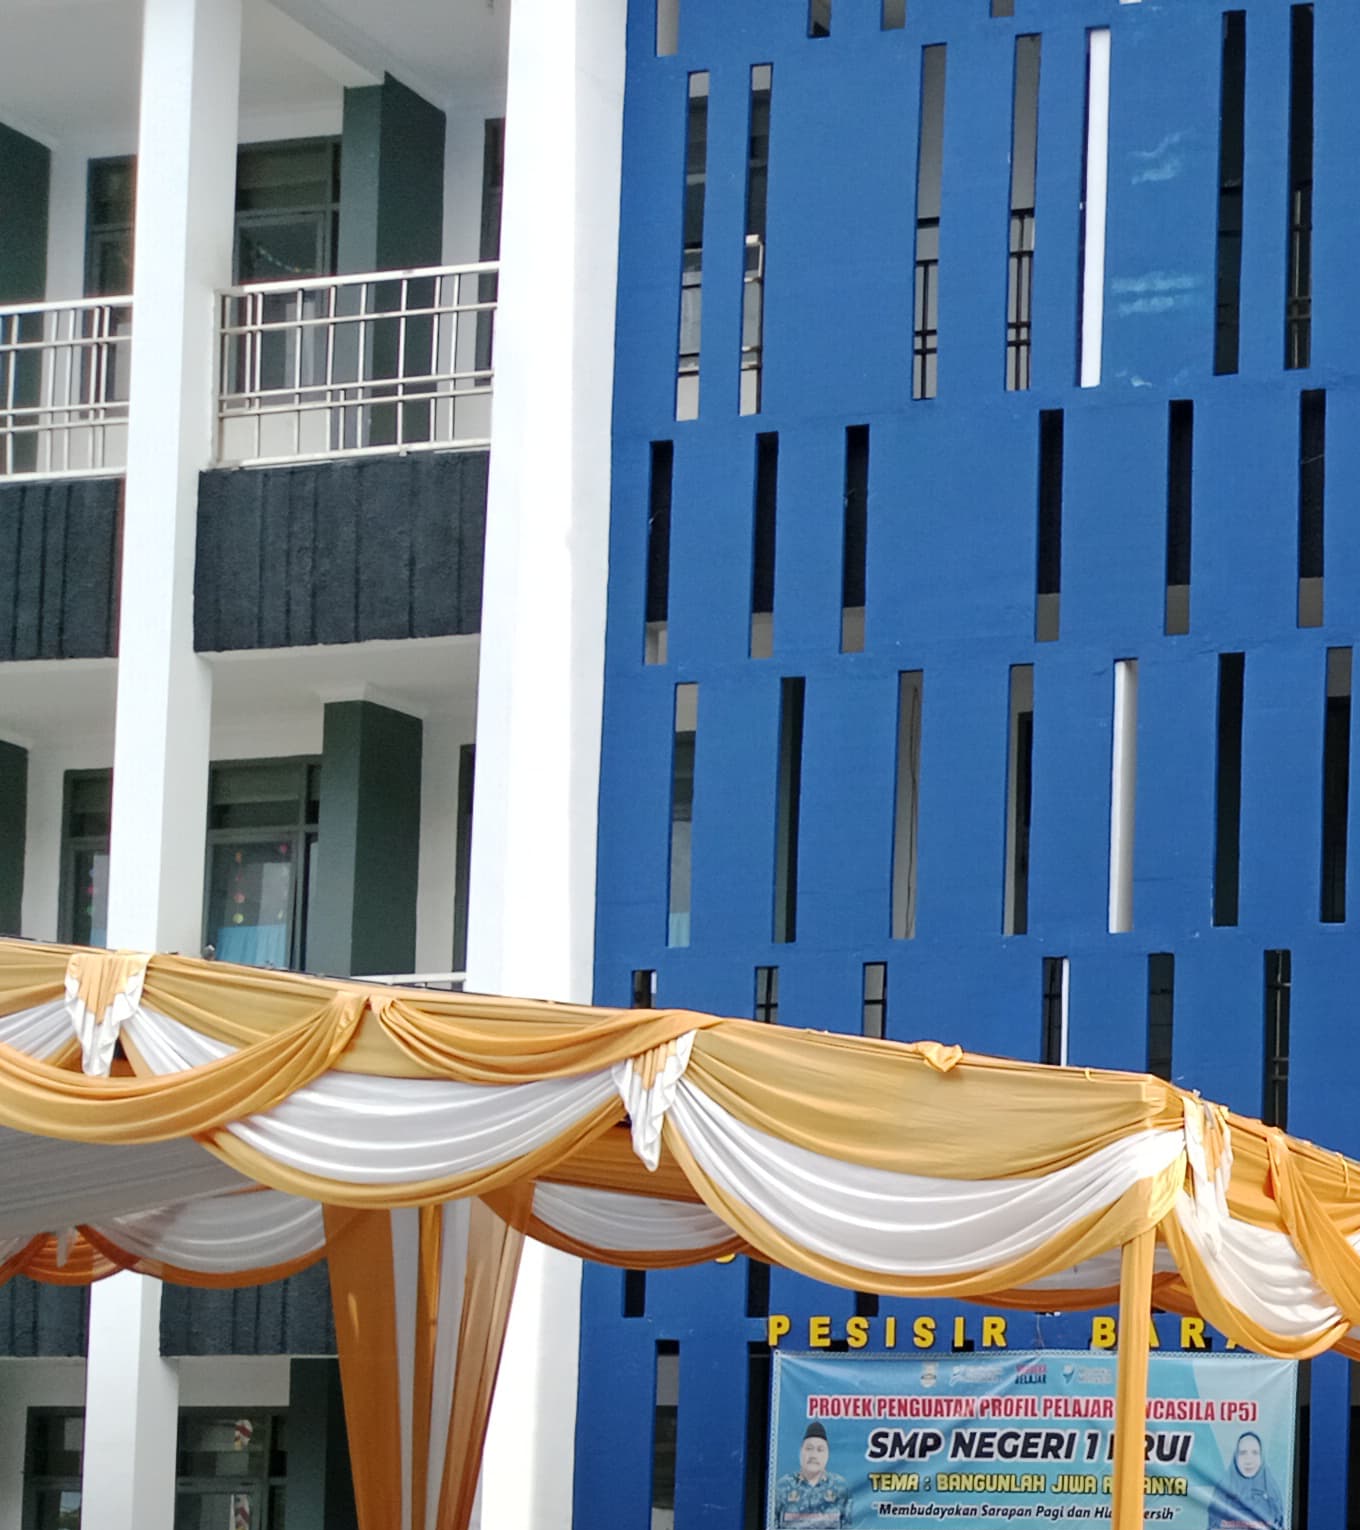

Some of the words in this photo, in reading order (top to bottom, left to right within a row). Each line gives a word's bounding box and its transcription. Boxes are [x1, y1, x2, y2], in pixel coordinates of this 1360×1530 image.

[768, 1315, 1007, 1348] PESISIR
[808, 1397, 875, 1417] PROYEK
[877, 1397, 976, 1418] PENGUATAN
[980, 1398, 1038, 1418] PROFIL
[1044, 1398, 1113, 1418] PELAJAR
[1146, 1400, 1215, 1421] CASILA
[1220, 1402, 1257, 1422] (P5)
[868, 1431, 942, 1459] SMP
[950, 1432, 1077, 1460] NEGERI
[1086, 1432, 1099, 1460] 1
[1107, 1433, 1192, 1462] RUI
[869, 1473, 918, 1492] TEMA
[937, 1473, 1046, 1493] BANGUNLAH
[1052, 1475, 1097, 1494] JIWA
[981, 1504, 1031, 1519] Sarapan
[1036, 1506, 1064, 1521] Pagi
[1067, 1506, 1090, 1519] dan
